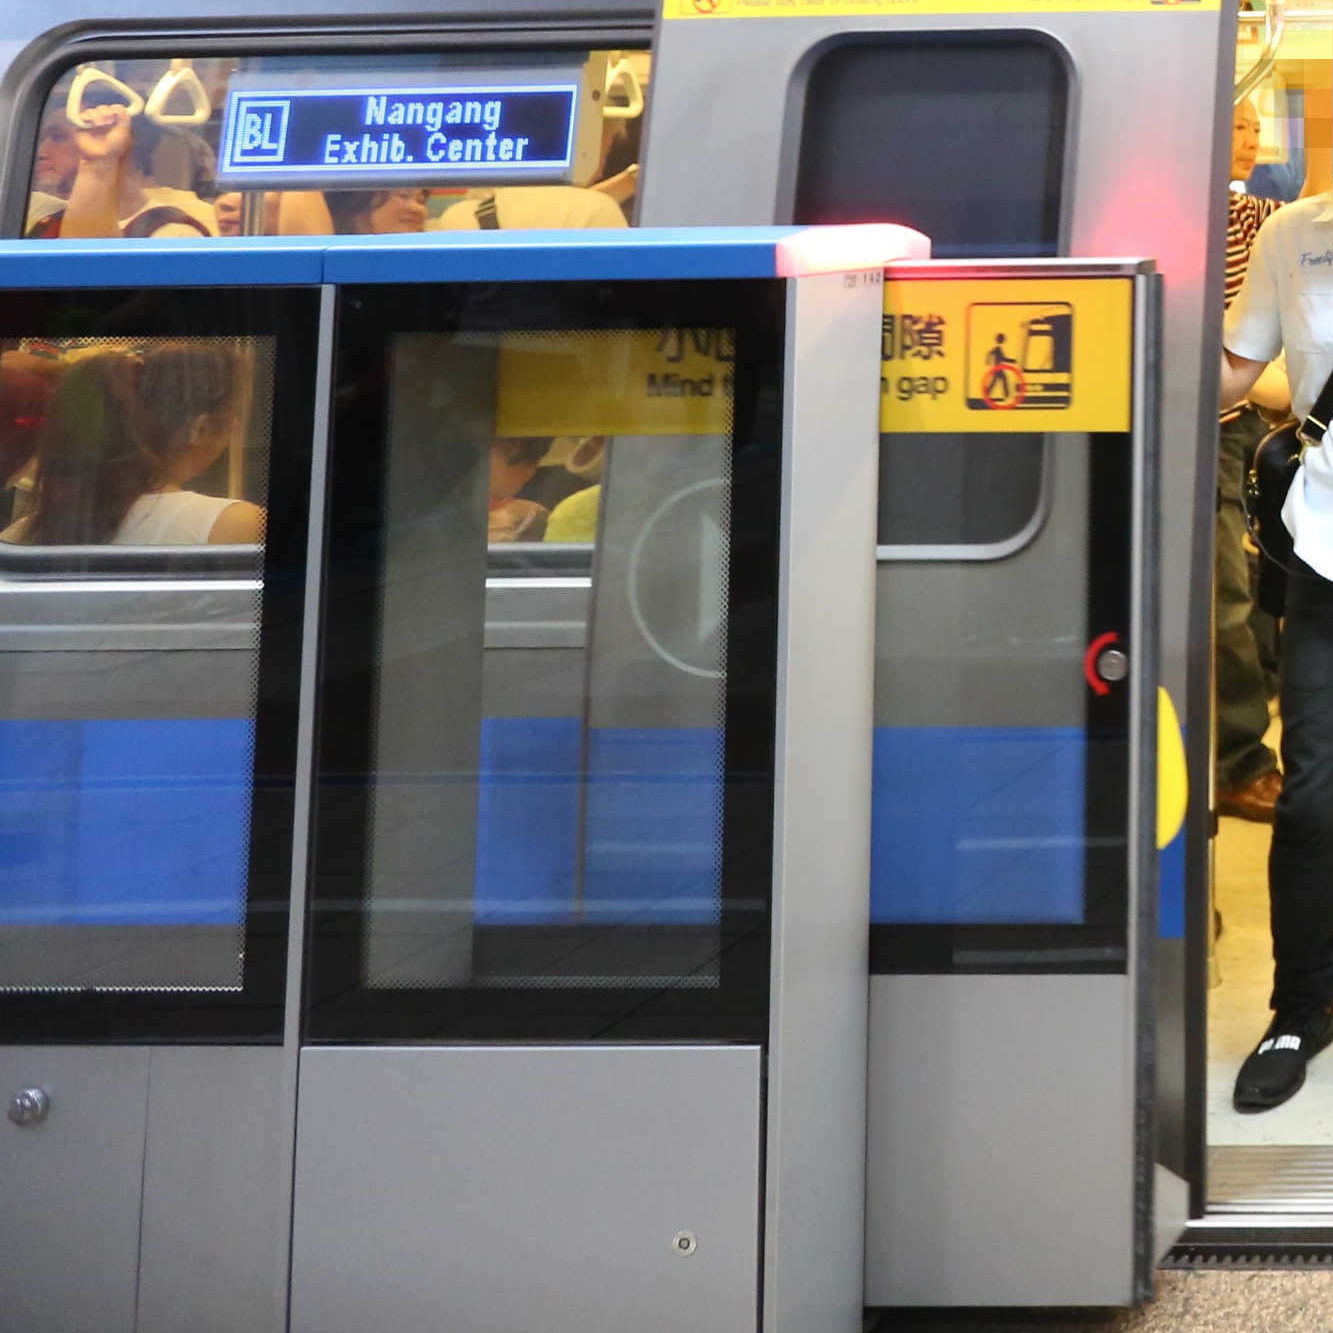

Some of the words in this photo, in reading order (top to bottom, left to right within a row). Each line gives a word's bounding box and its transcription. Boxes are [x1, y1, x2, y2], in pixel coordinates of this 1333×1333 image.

[365, 96, 502, 131] Nangang
[242, 112, 280, 151] BL
[324, 133, 414, 165] Exhib.
[426, 133, 529, 162] Center
[897, 375, 948, 401] gap
